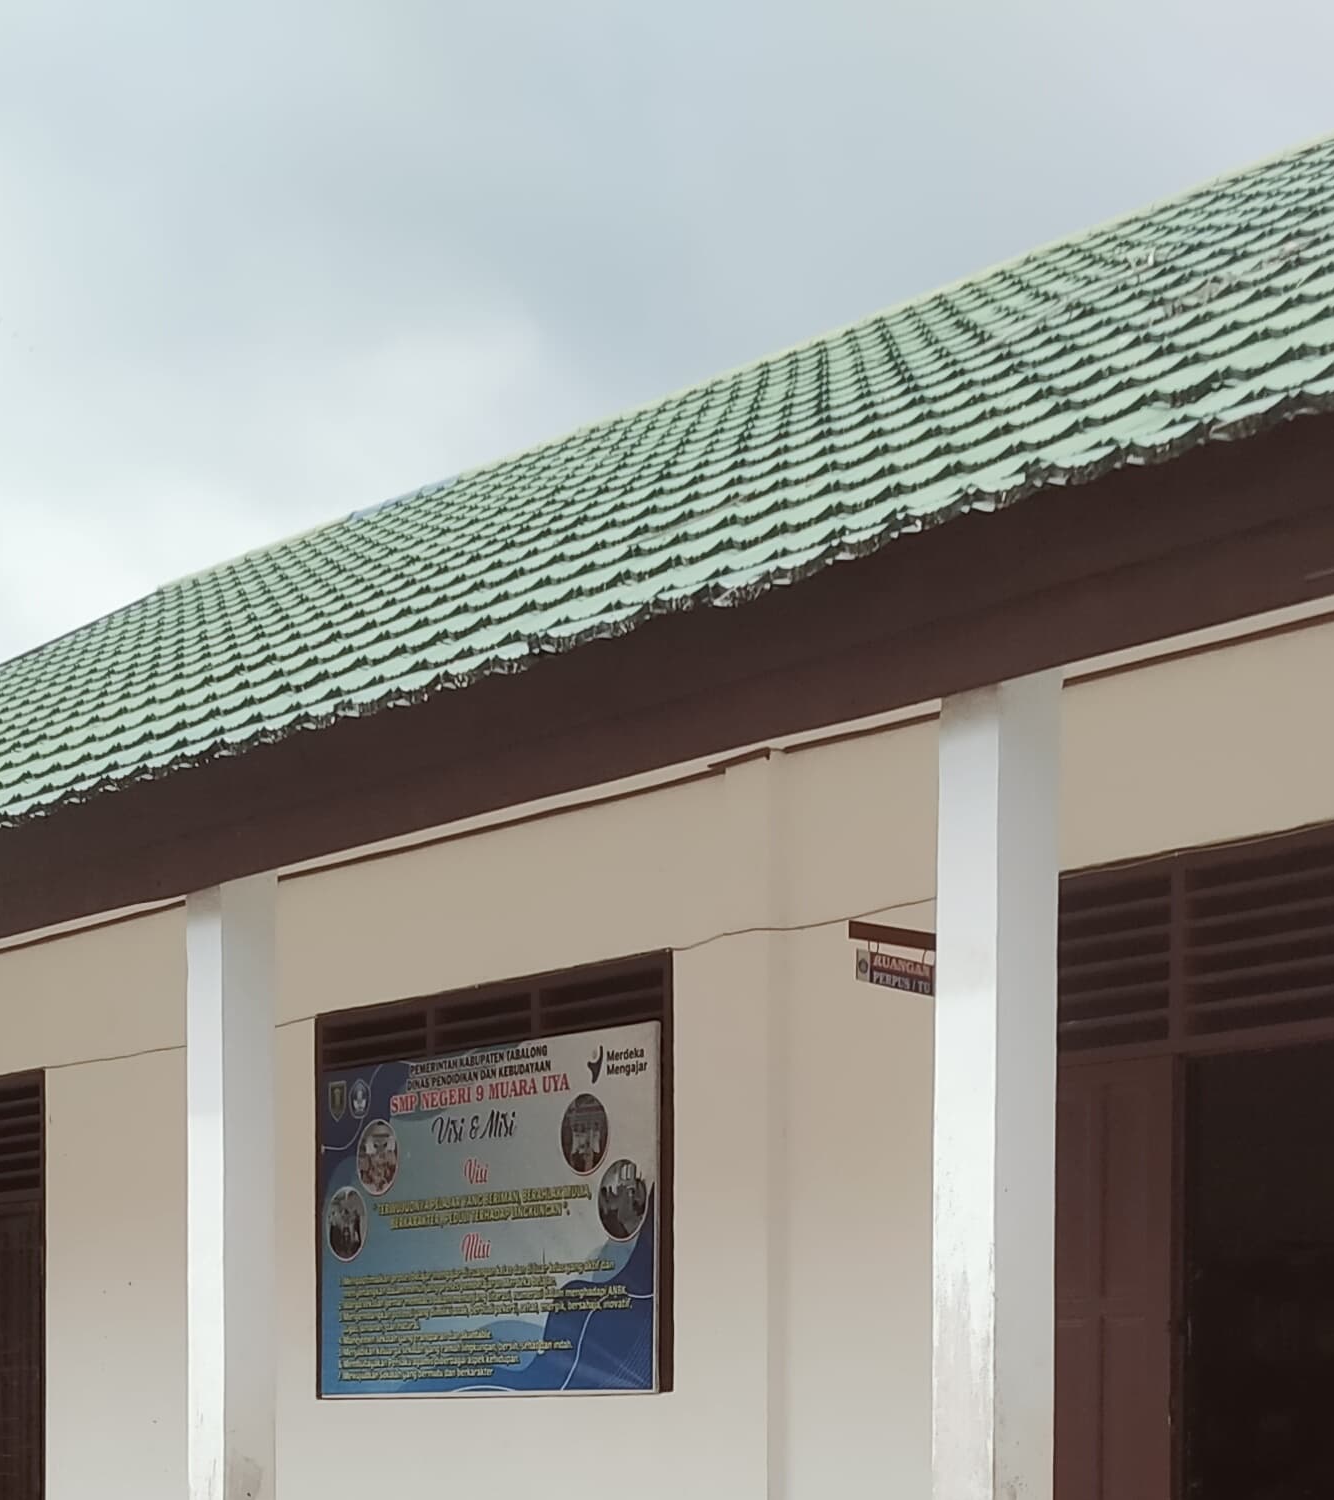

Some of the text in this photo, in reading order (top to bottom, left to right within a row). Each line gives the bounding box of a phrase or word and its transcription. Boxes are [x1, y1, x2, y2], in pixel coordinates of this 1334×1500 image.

[873, 955, 930, 977] RUANGAN
[410, 1060, 457, 1075] PEMERINTAH
[459, 1052, 504, 1068] KABUPATEN
[607, 1048, 644, 1061] Merdeka
[432, 1071, 478, 1087] PENDIDIKAN
[480, 1068, 496, 1081] DAN
[498, 1060, 551, 1077] KEBUDAYAAN
[607, 1061, 648, 1076] Mengajar
[391, 1073, 570, 1113] SMP NEGERI 9 MUARA UYA
[432, 1116, 465, 1144] Visi
[480, 1110, 515, 1139] Misi
[464, 1159, 488, 1184] Visi
[461, 1233, 491, 1262] Misi
